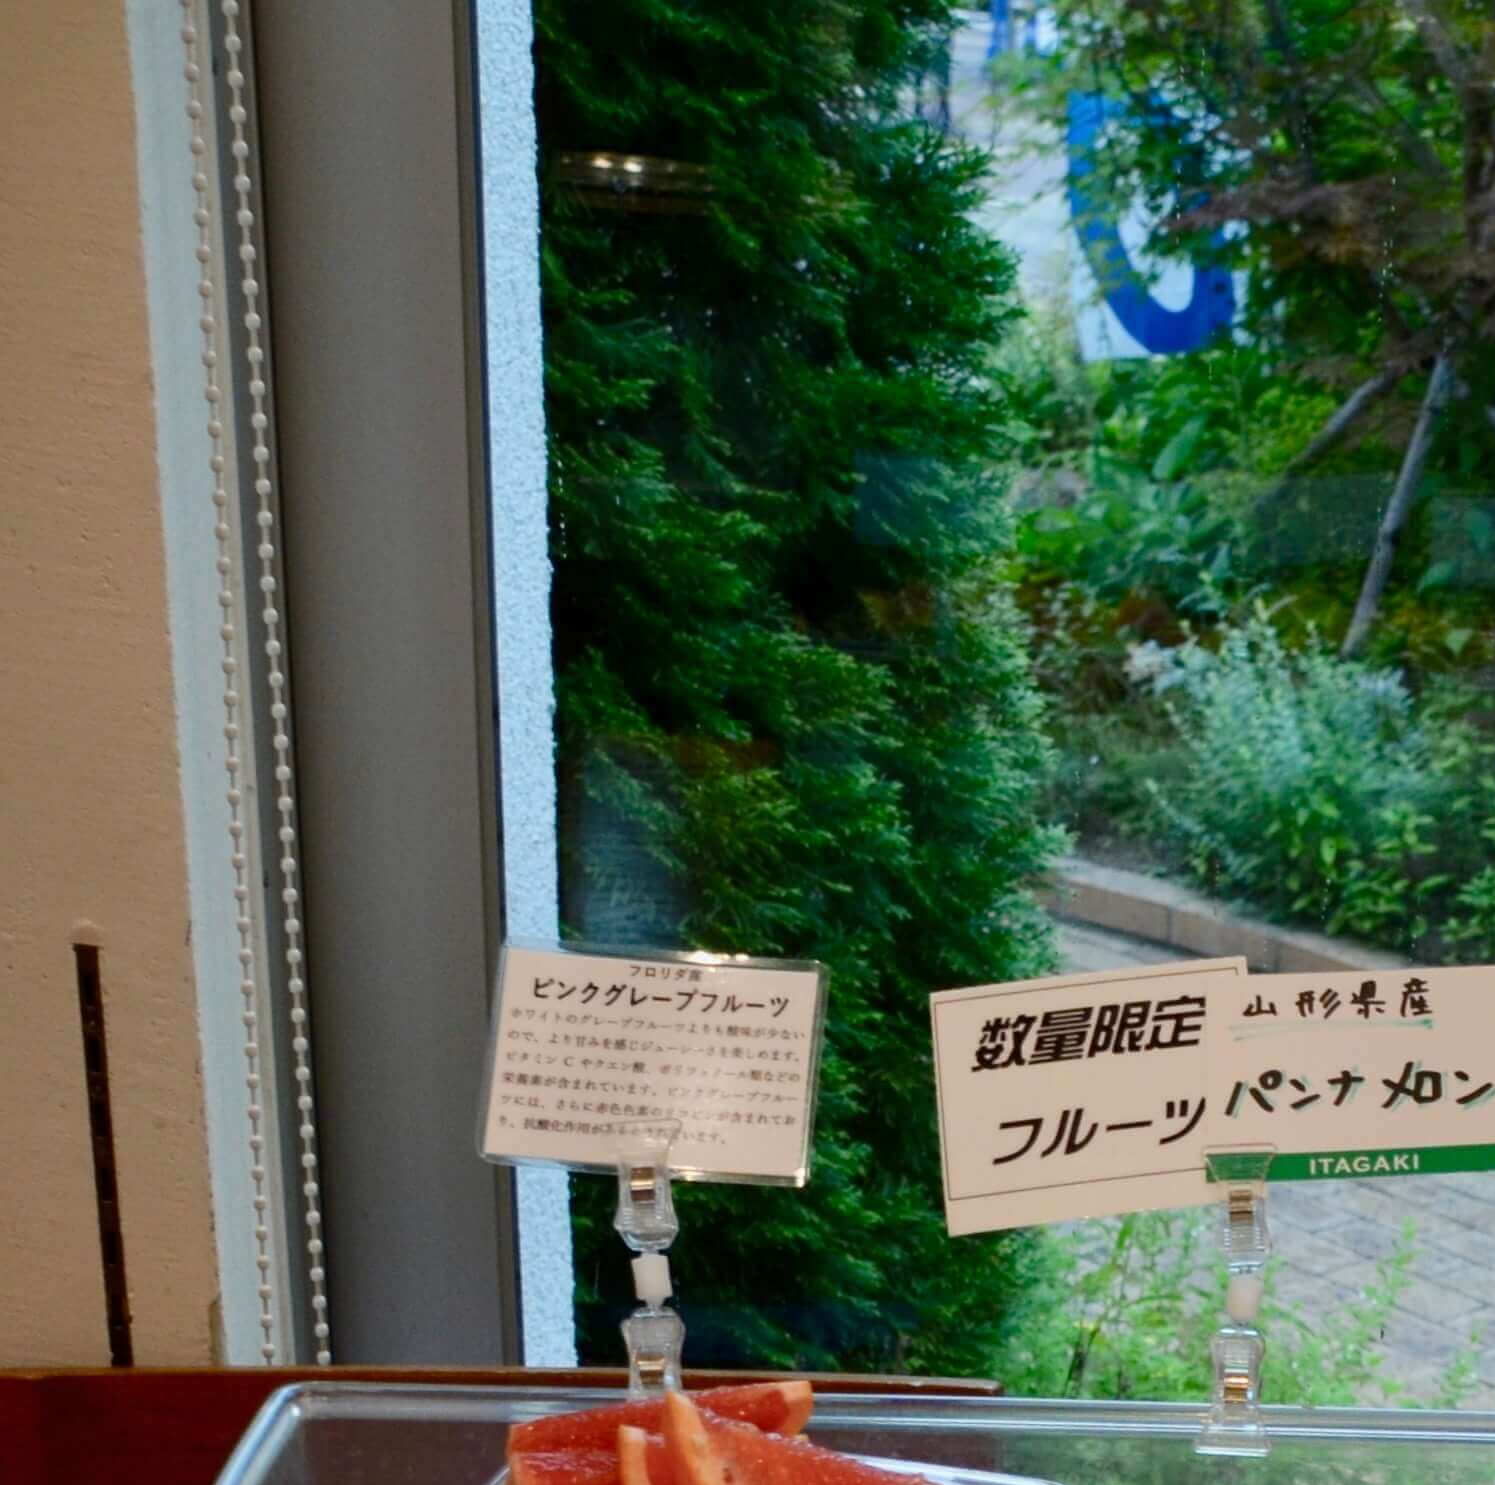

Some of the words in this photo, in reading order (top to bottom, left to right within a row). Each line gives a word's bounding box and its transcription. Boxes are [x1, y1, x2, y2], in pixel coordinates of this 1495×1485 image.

[630, 966, 702, 981] フロリダ産
[534, 978, 789, 1018] ピンクグレープフルーツ
[1242, 978, 1432, 1019] 山形県産
[971, 996, 1206, 1072] 数量限定
[1225, 1061, 1493, 1115] パンナメロン
[993, 1097, 1206, 1164] フルーツ
[1309, 1154, 1419, 1175] ITAGAKI
